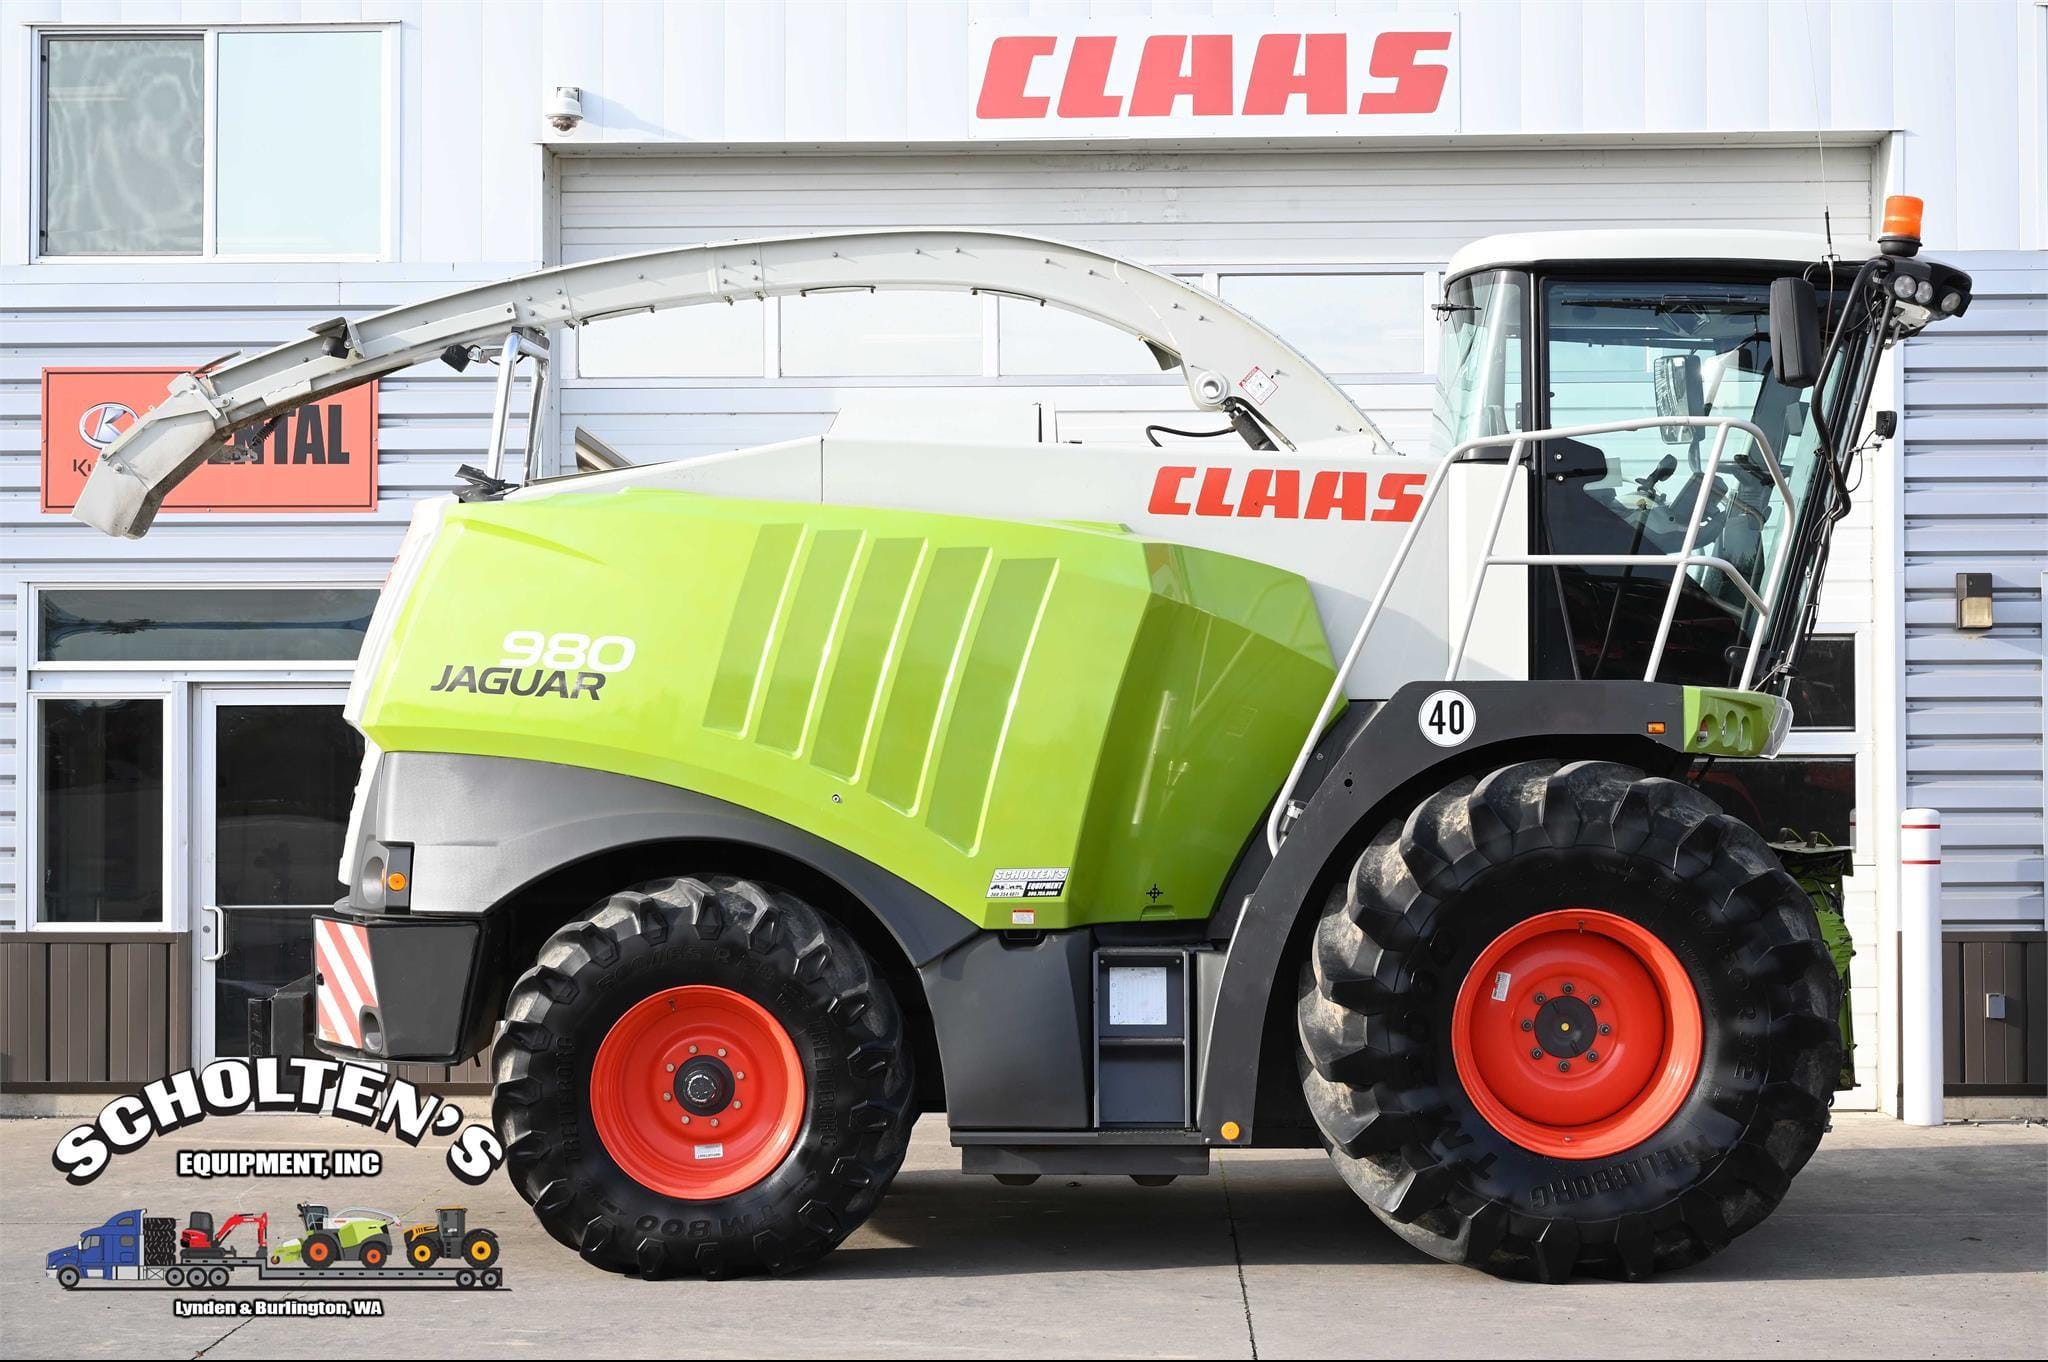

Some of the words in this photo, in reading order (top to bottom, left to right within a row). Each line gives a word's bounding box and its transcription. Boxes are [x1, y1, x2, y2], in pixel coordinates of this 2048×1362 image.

[975, 31, 1452, 119] CLAAS
[1147, 466, 1427, 522] CLAAS
[500, 630, 636, 673] 980
[430, 664, 606, 700] JAGUAR
[1428, 700, 1465, 735] 40
